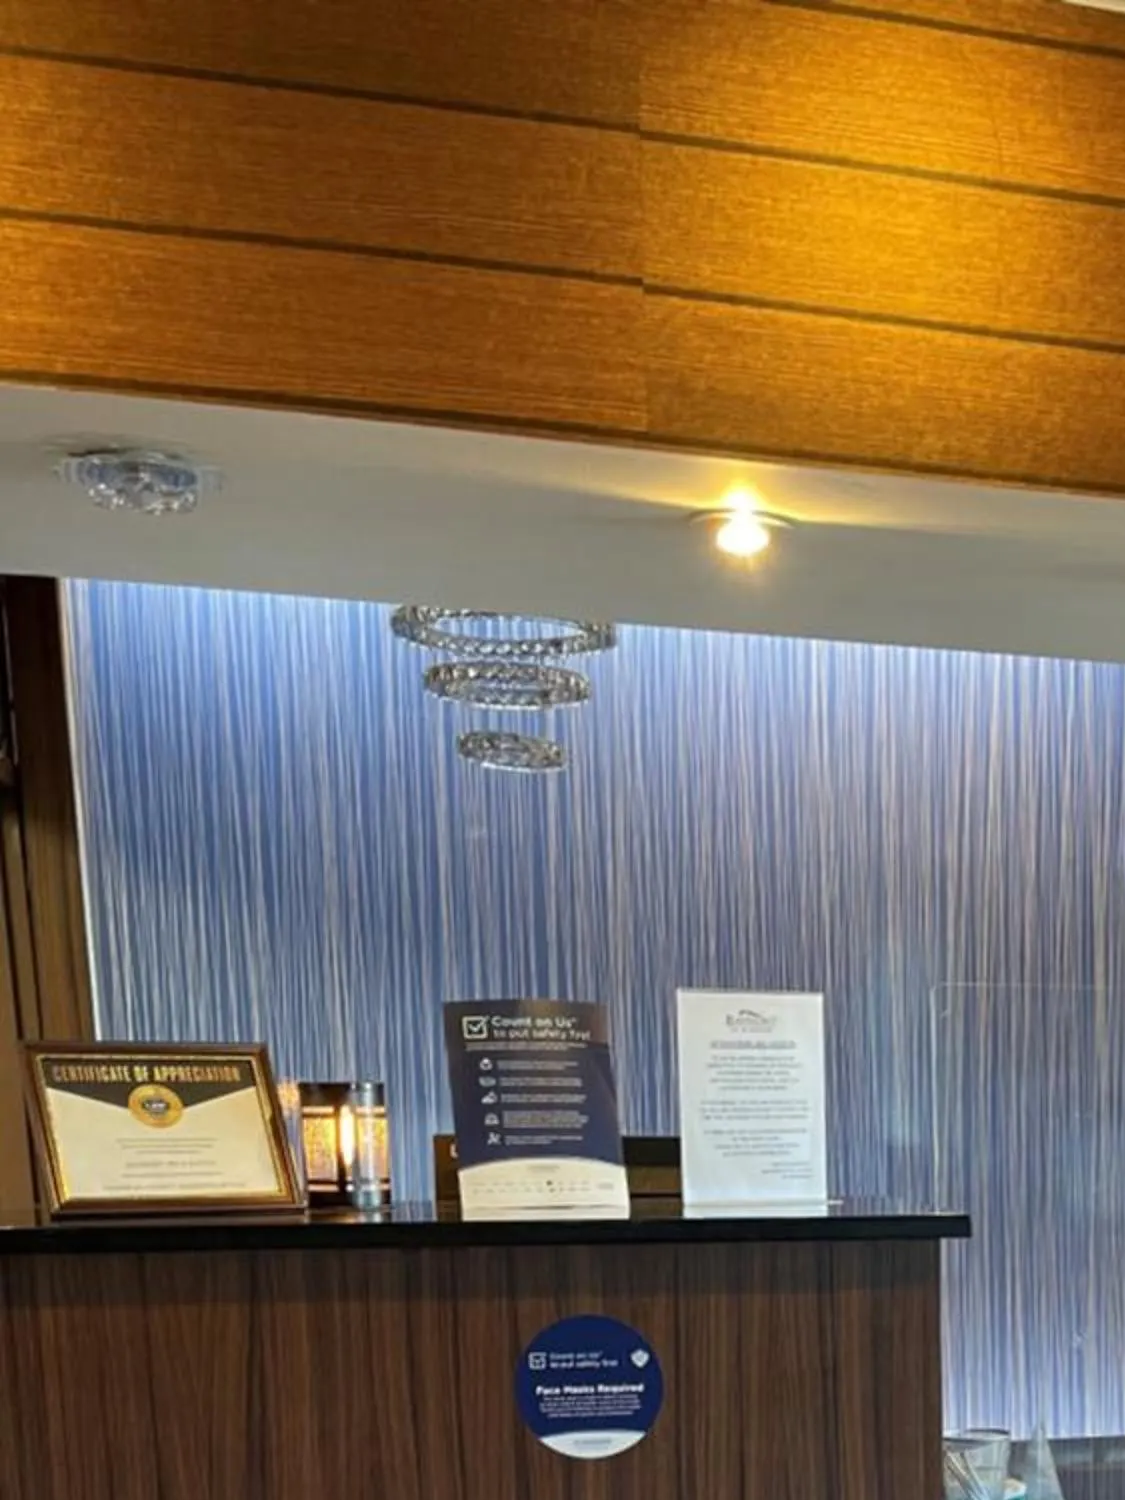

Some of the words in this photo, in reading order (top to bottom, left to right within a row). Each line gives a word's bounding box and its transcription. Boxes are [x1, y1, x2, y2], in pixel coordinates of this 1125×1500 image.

[52, 1065, 132, 1083] CERTIFICATE
[133, 1065, 149, 1083] OF
[152, 1065, 241, 1083] APPRECIATION
[536, 1385, 561, 1395] Face
[597, 1383, 645, 1394] Required
